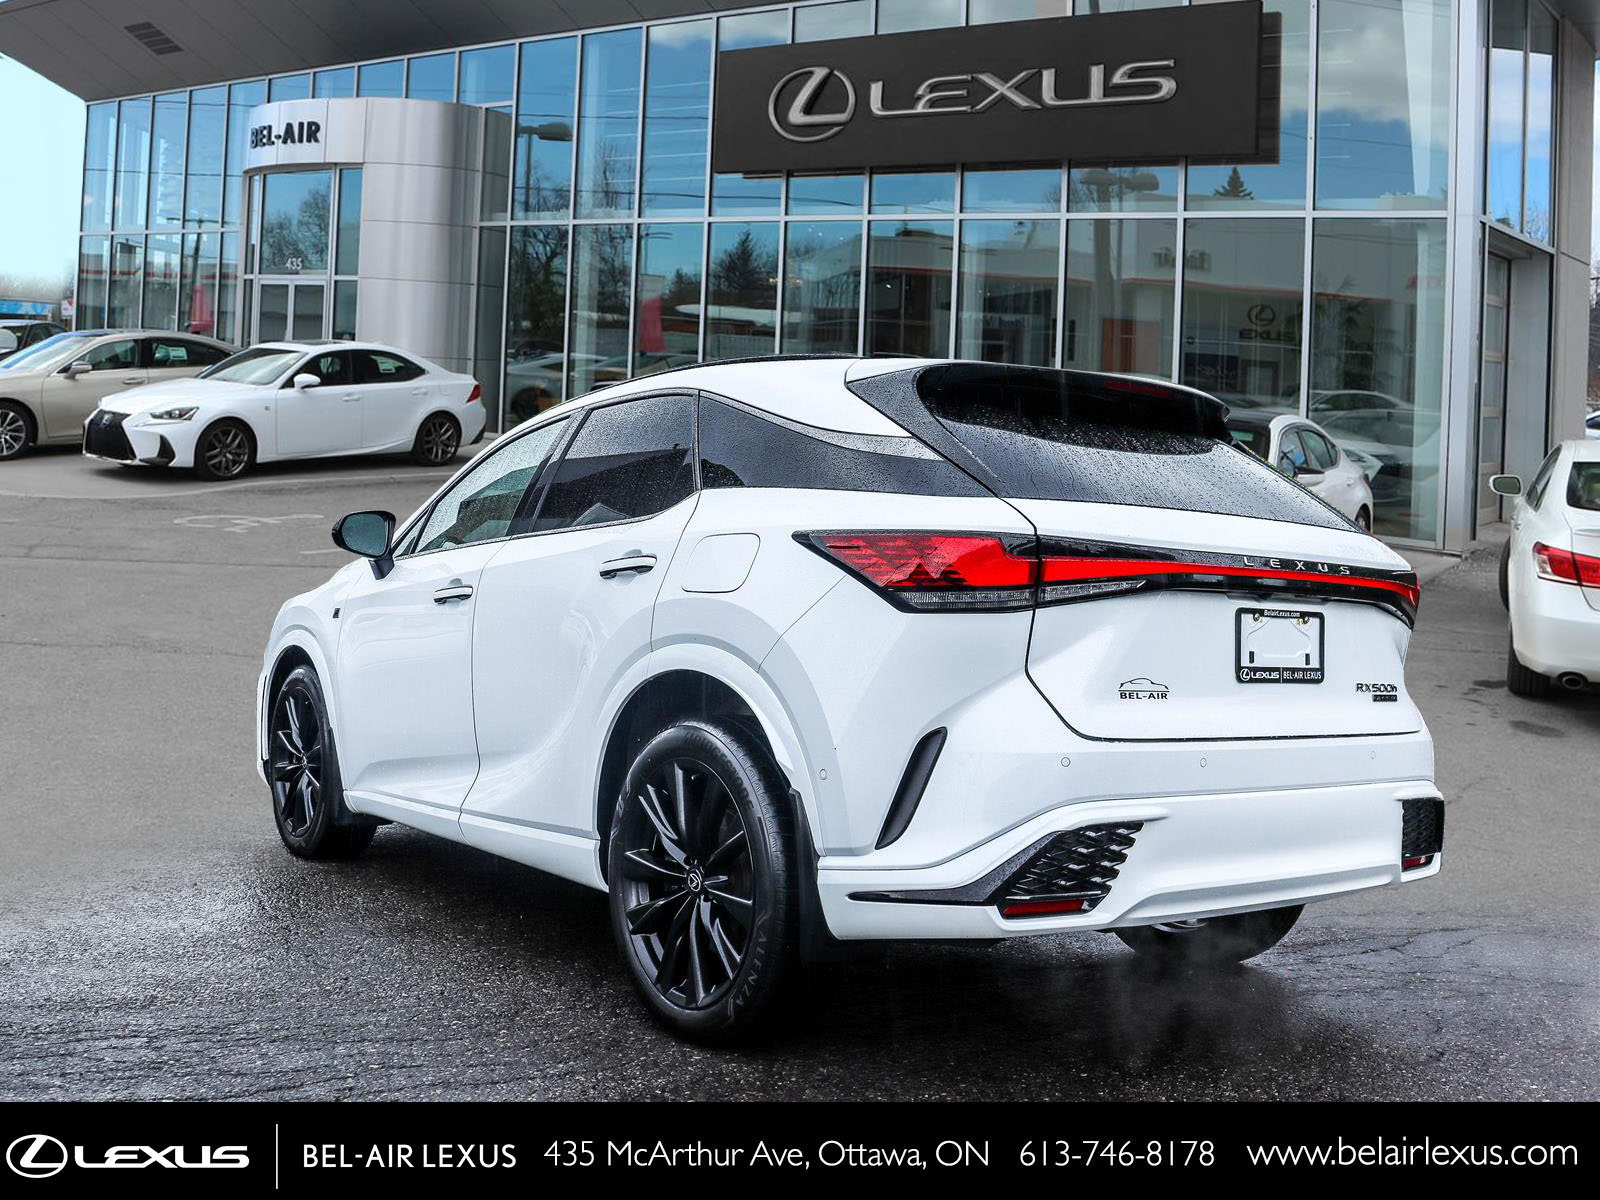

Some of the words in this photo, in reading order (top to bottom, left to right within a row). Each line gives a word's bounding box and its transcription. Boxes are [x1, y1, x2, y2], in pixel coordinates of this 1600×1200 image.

[869, 59, 1177, 119] LEXUS
[250, 121, 321, 149] BEL-AIR
[286, 257, 303, 270] 435
[1243, 556, 1351, 575] LEXUS
[1264, 609, 1301, 618] BelairLexus.com
[1251, 671, 1280, 679] LEXUS
[1283, 671, 1304, 679] BEL-AIR
[1304, 671, 1321, 680] LEXUS
[1120, 692, 1168, 700] BEL-AIR
[736, 930, 767, 1006] ALENZA
